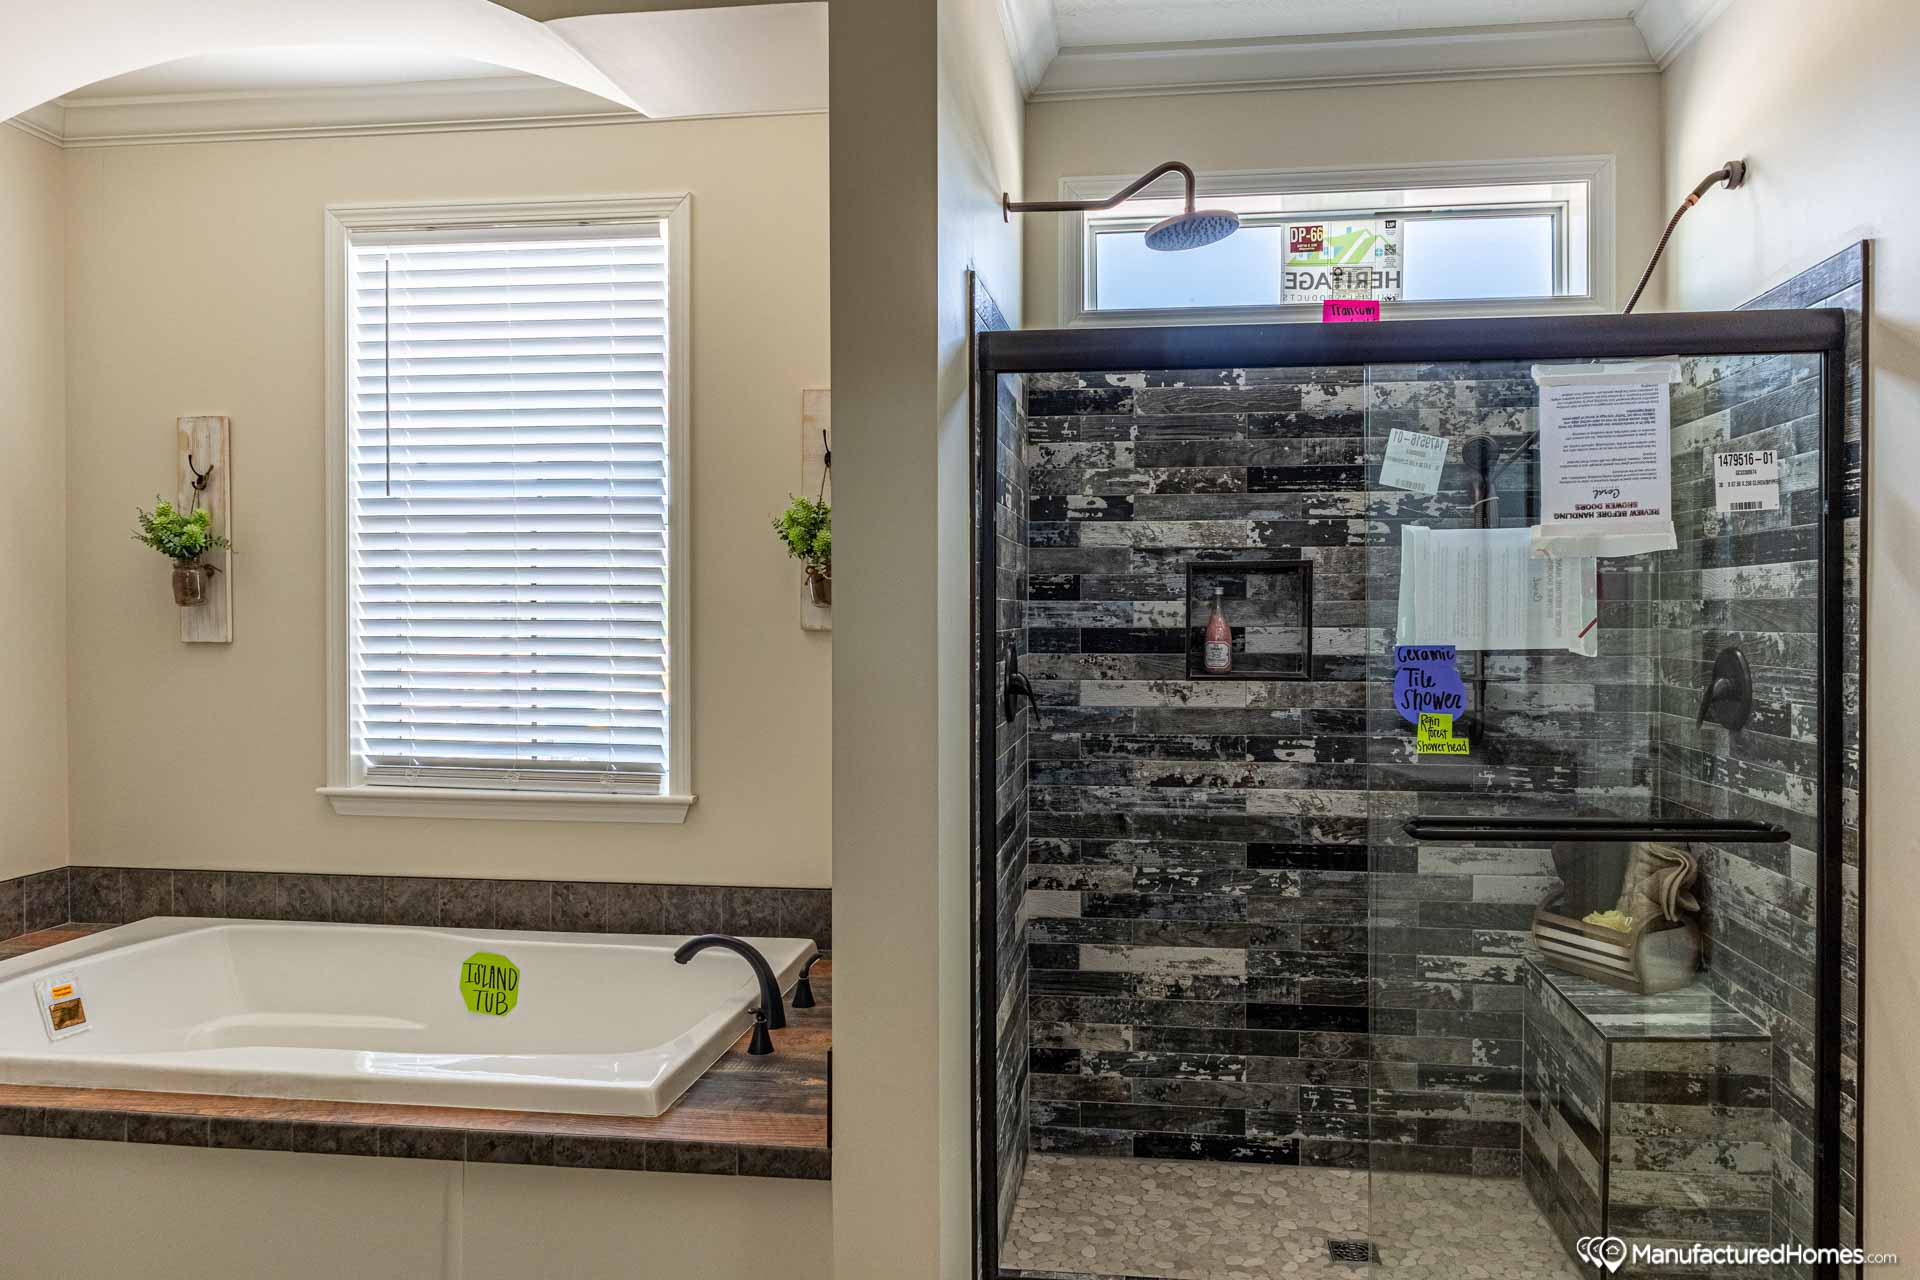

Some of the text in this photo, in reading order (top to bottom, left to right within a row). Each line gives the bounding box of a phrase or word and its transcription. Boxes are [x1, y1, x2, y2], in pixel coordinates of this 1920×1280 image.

[1290, 226, 1323, 243] DP-66
[1593, 489, 1620, 499] Coral
[1554, 508, 1660, 520] REVIEW BEFORE HANDLING
[1575, 502, 1638, 511] SHOWER DOORS
[1398, 646, 1454, 662] Ceramic
[1403, 667, 1436, 688] Tile
[1401, 689, 1462, 711] Shower
[1421, 714, 1440, 731] Rain
[464, 963, 517, 991] ISLAND
[472, 989, 508, 1015] TUB
